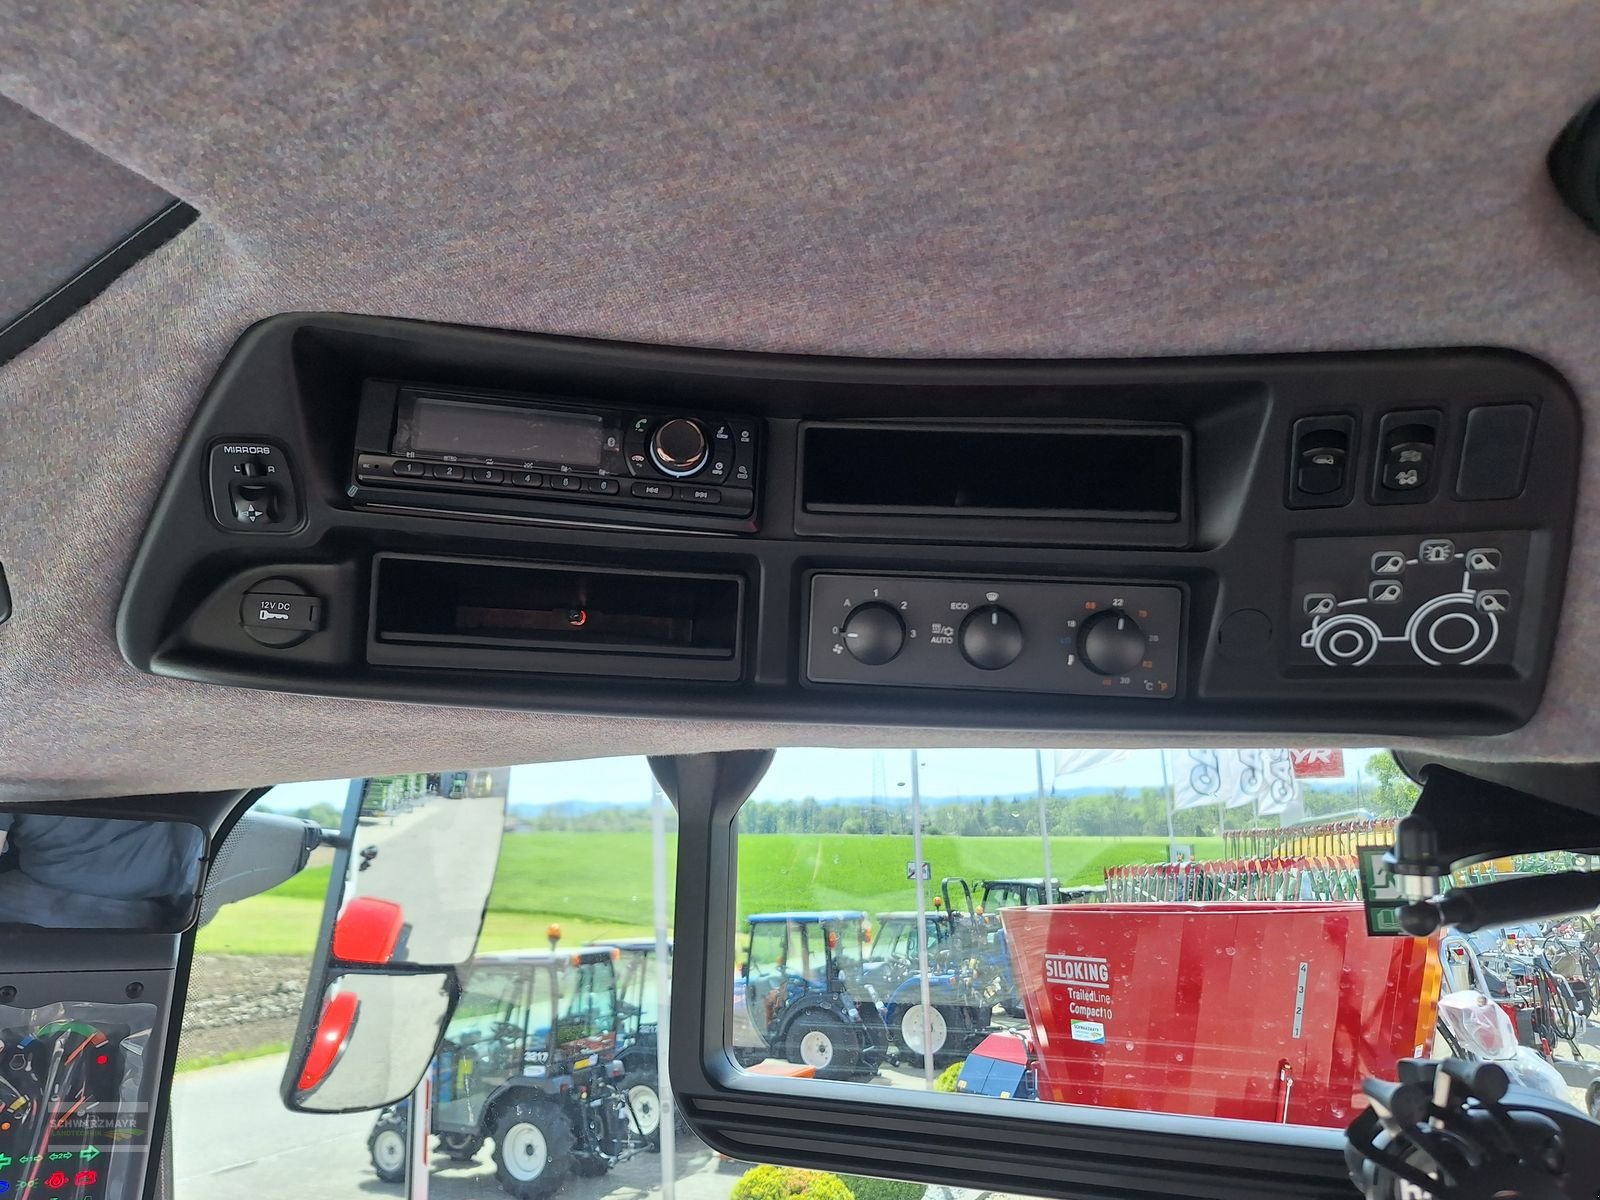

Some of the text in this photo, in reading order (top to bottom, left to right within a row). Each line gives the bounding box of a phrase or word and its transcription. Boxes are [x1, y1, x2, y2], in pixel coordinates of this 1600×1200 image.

[223, 446, 271, 455] MIRRORS
[267, 465, 275, 473] R
[447, 467, 453, 475] 2
[486, 471, 492, 479] 3
[873, 589, 879, 597] 1
[260, 601, 290, 610] 12V DC
[843, 599, 851, 607] A
[900, 601, 908, 610] 2
[950, 602, 969, 610] ECO
[1112, 598, 1124, 607] 22
[910, 630, 917, 638] 3
[930, 636, 954, 644] AUTO
[1045, 960, 1109, 982] SILOKING
[1300, 964, 1307, 972] 4
[1298, 985, 1304, 993] 3
[1296, 1006, 1302, 1014] 2
